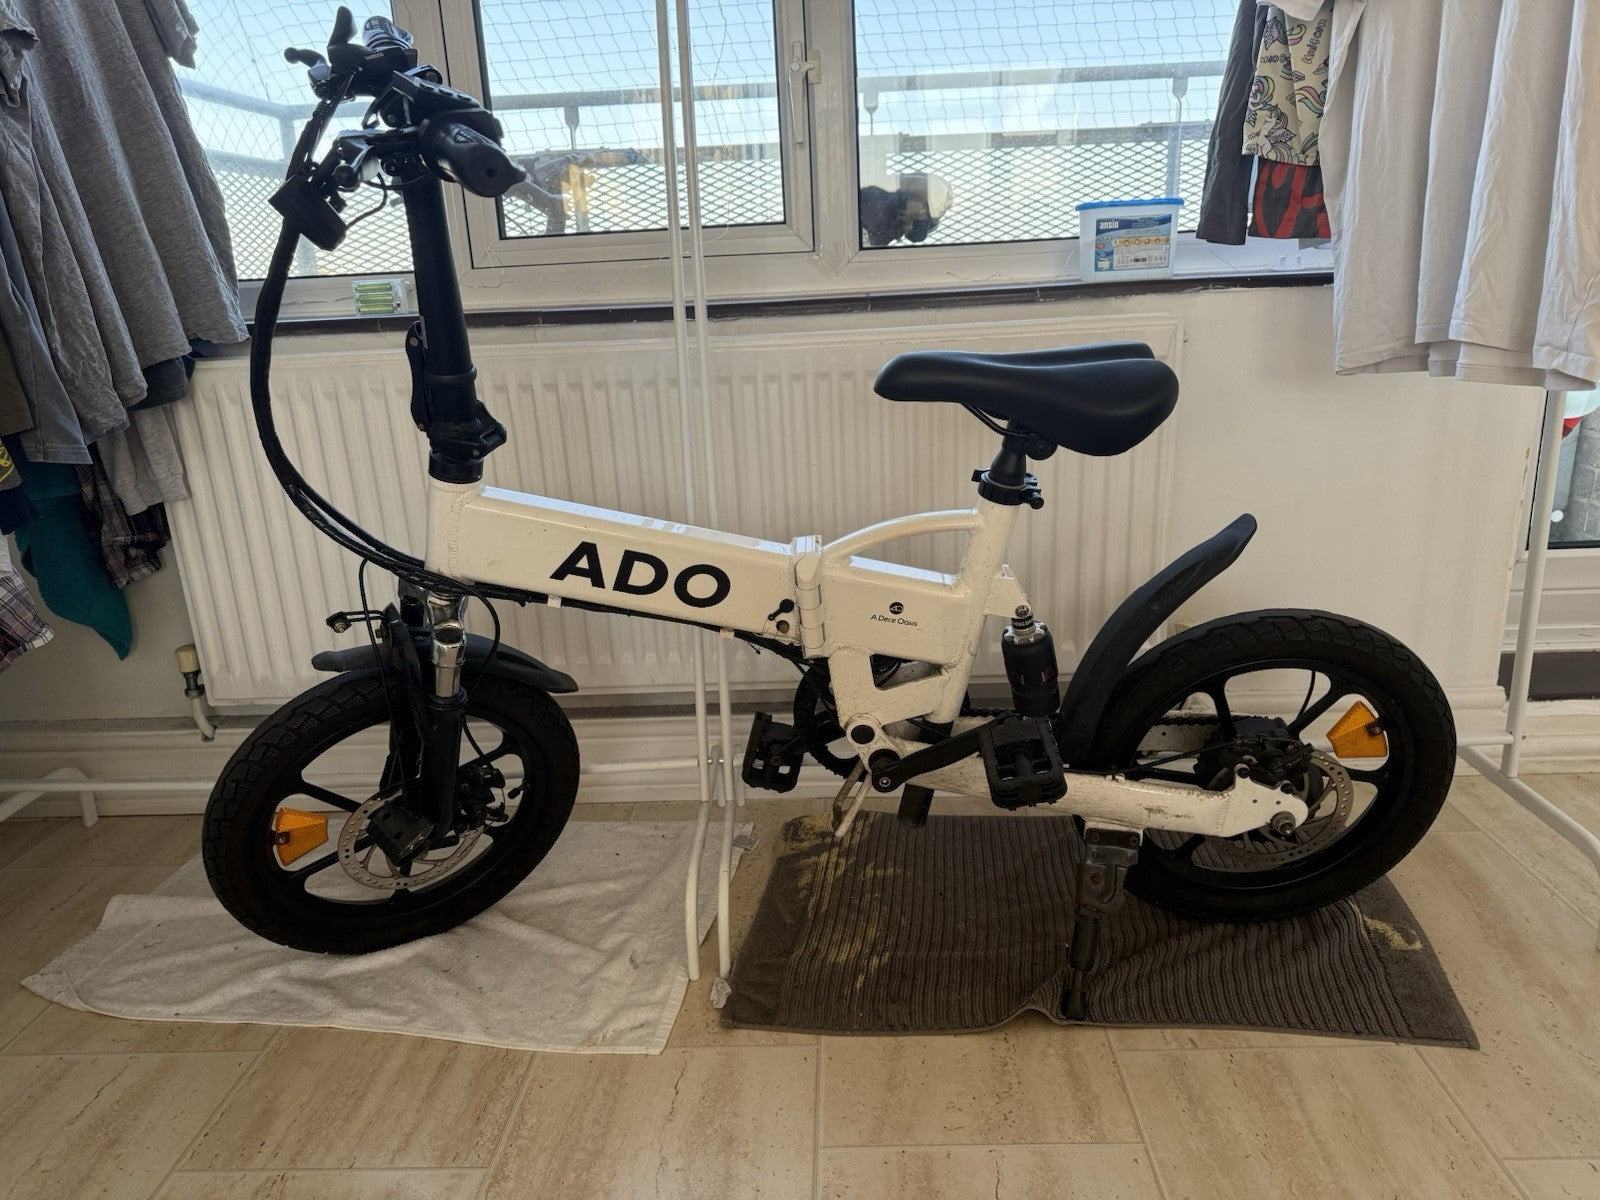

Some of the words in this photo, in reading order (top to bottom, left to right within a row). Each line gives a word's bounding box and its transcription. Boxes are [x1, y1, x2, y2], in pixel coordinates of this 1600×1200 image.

[1099, 218, 1120, 230] ansio
[549, 541, 731, 608] ADO
[878, 614, 896, 624] Dece
